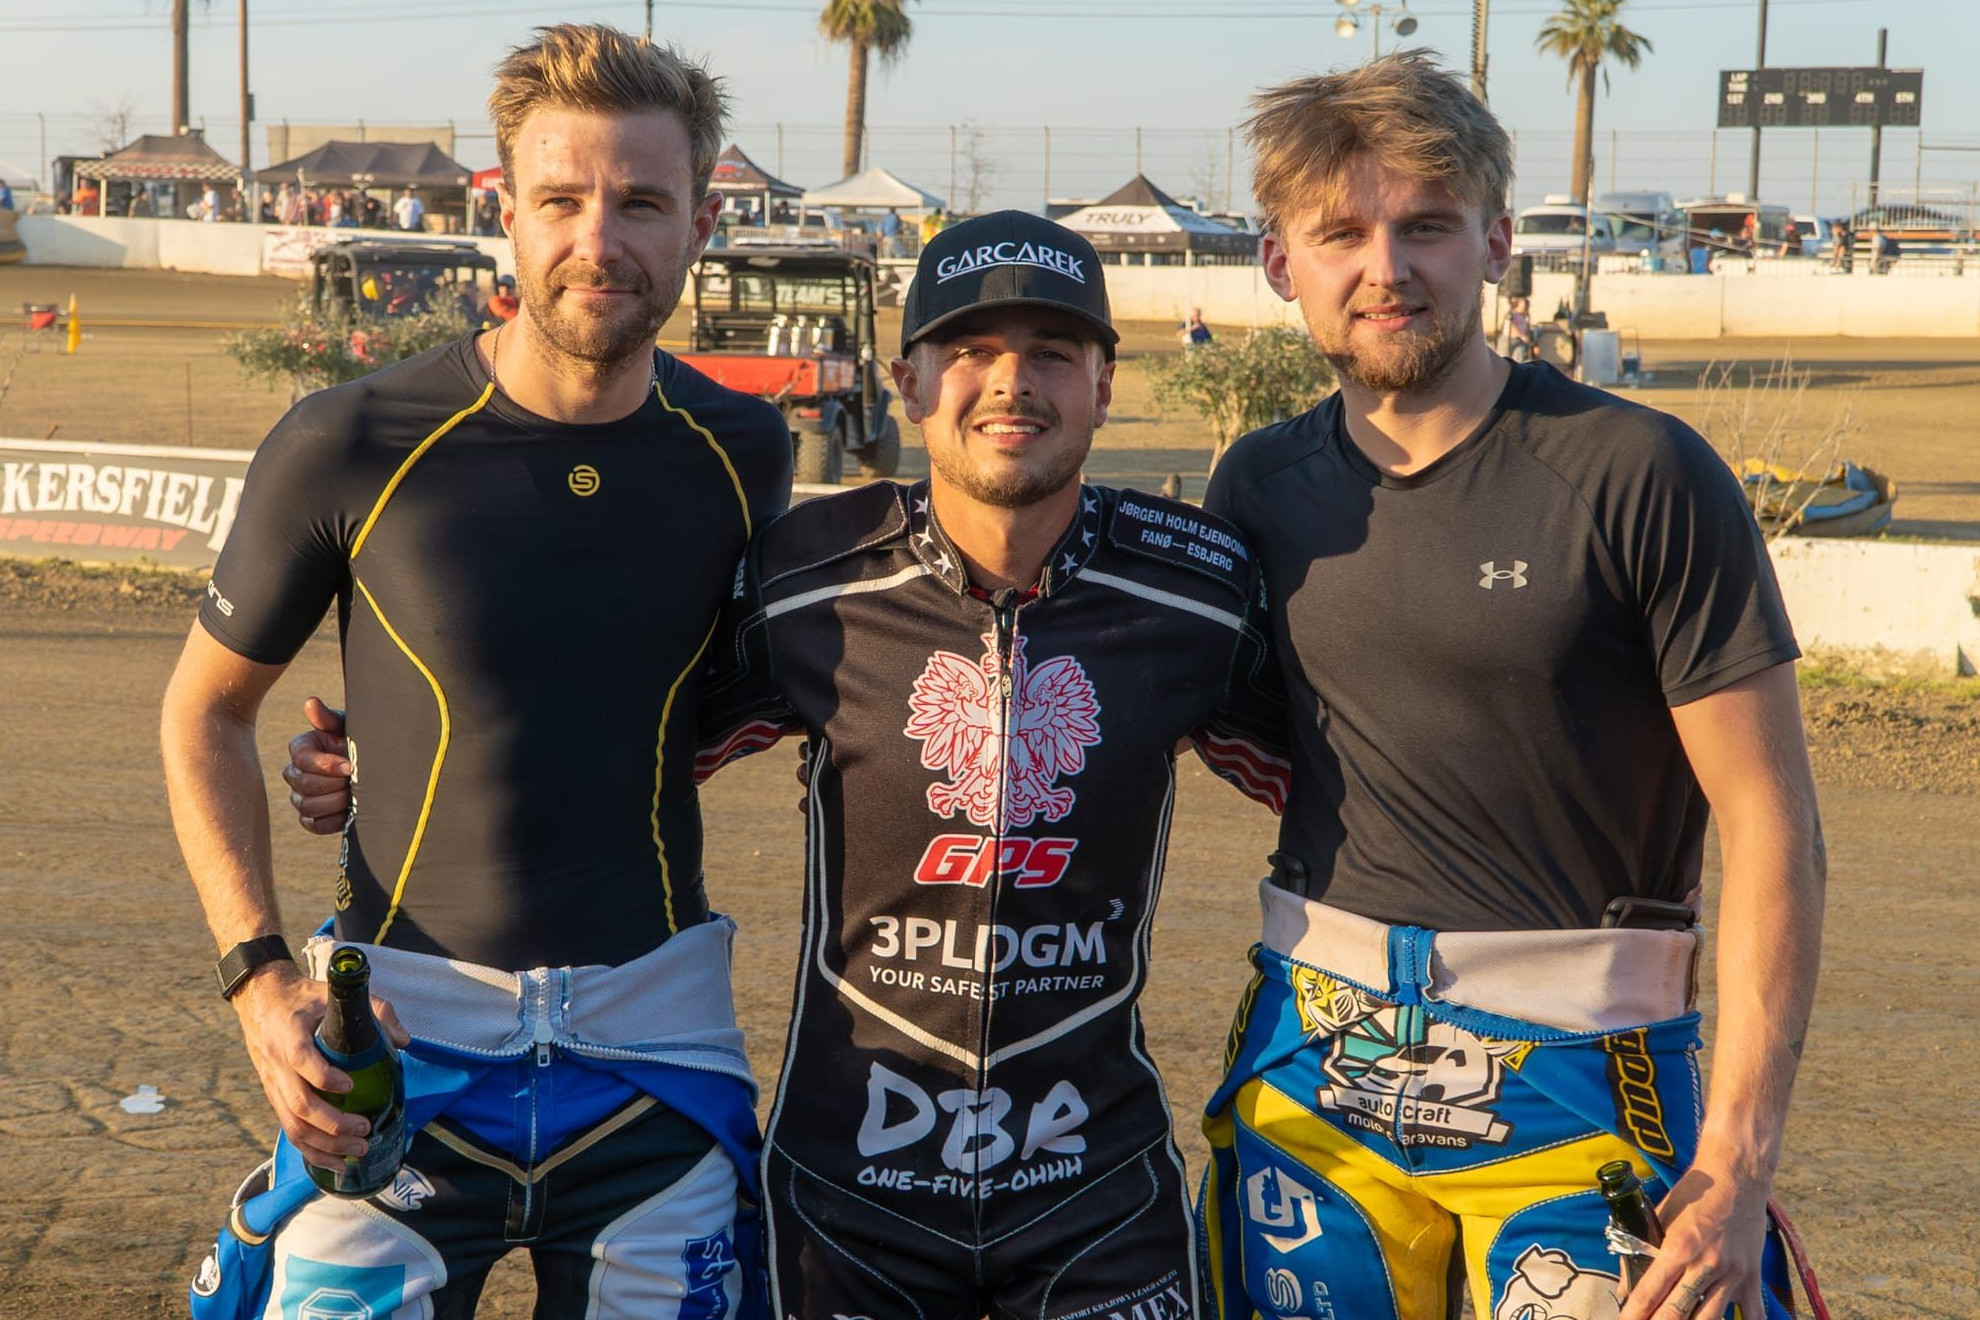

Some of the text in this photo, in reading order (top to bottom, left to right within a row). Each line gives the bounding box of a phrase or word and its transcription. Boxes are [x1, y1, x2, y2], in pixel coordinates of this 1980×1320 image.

[1764, 92, 1784, 104] 2ND
[1806, 92, 1827, 104] 3RD
[1854, 92, 1875, 103] 4TH
[1086, 212, 1153, 225] TRULY
[936, 241, 1085, 280] GARCAREK
[1119, 501, 1164, 525] JØRGEN
[1165, 513, 1198, 535] HOLM
[913, 834, 1079, 888] GPS
[869, 966, 1105, 1001] YOUR SAFEST PARTNER
[857, 1061, 1090, 1174] DBR
